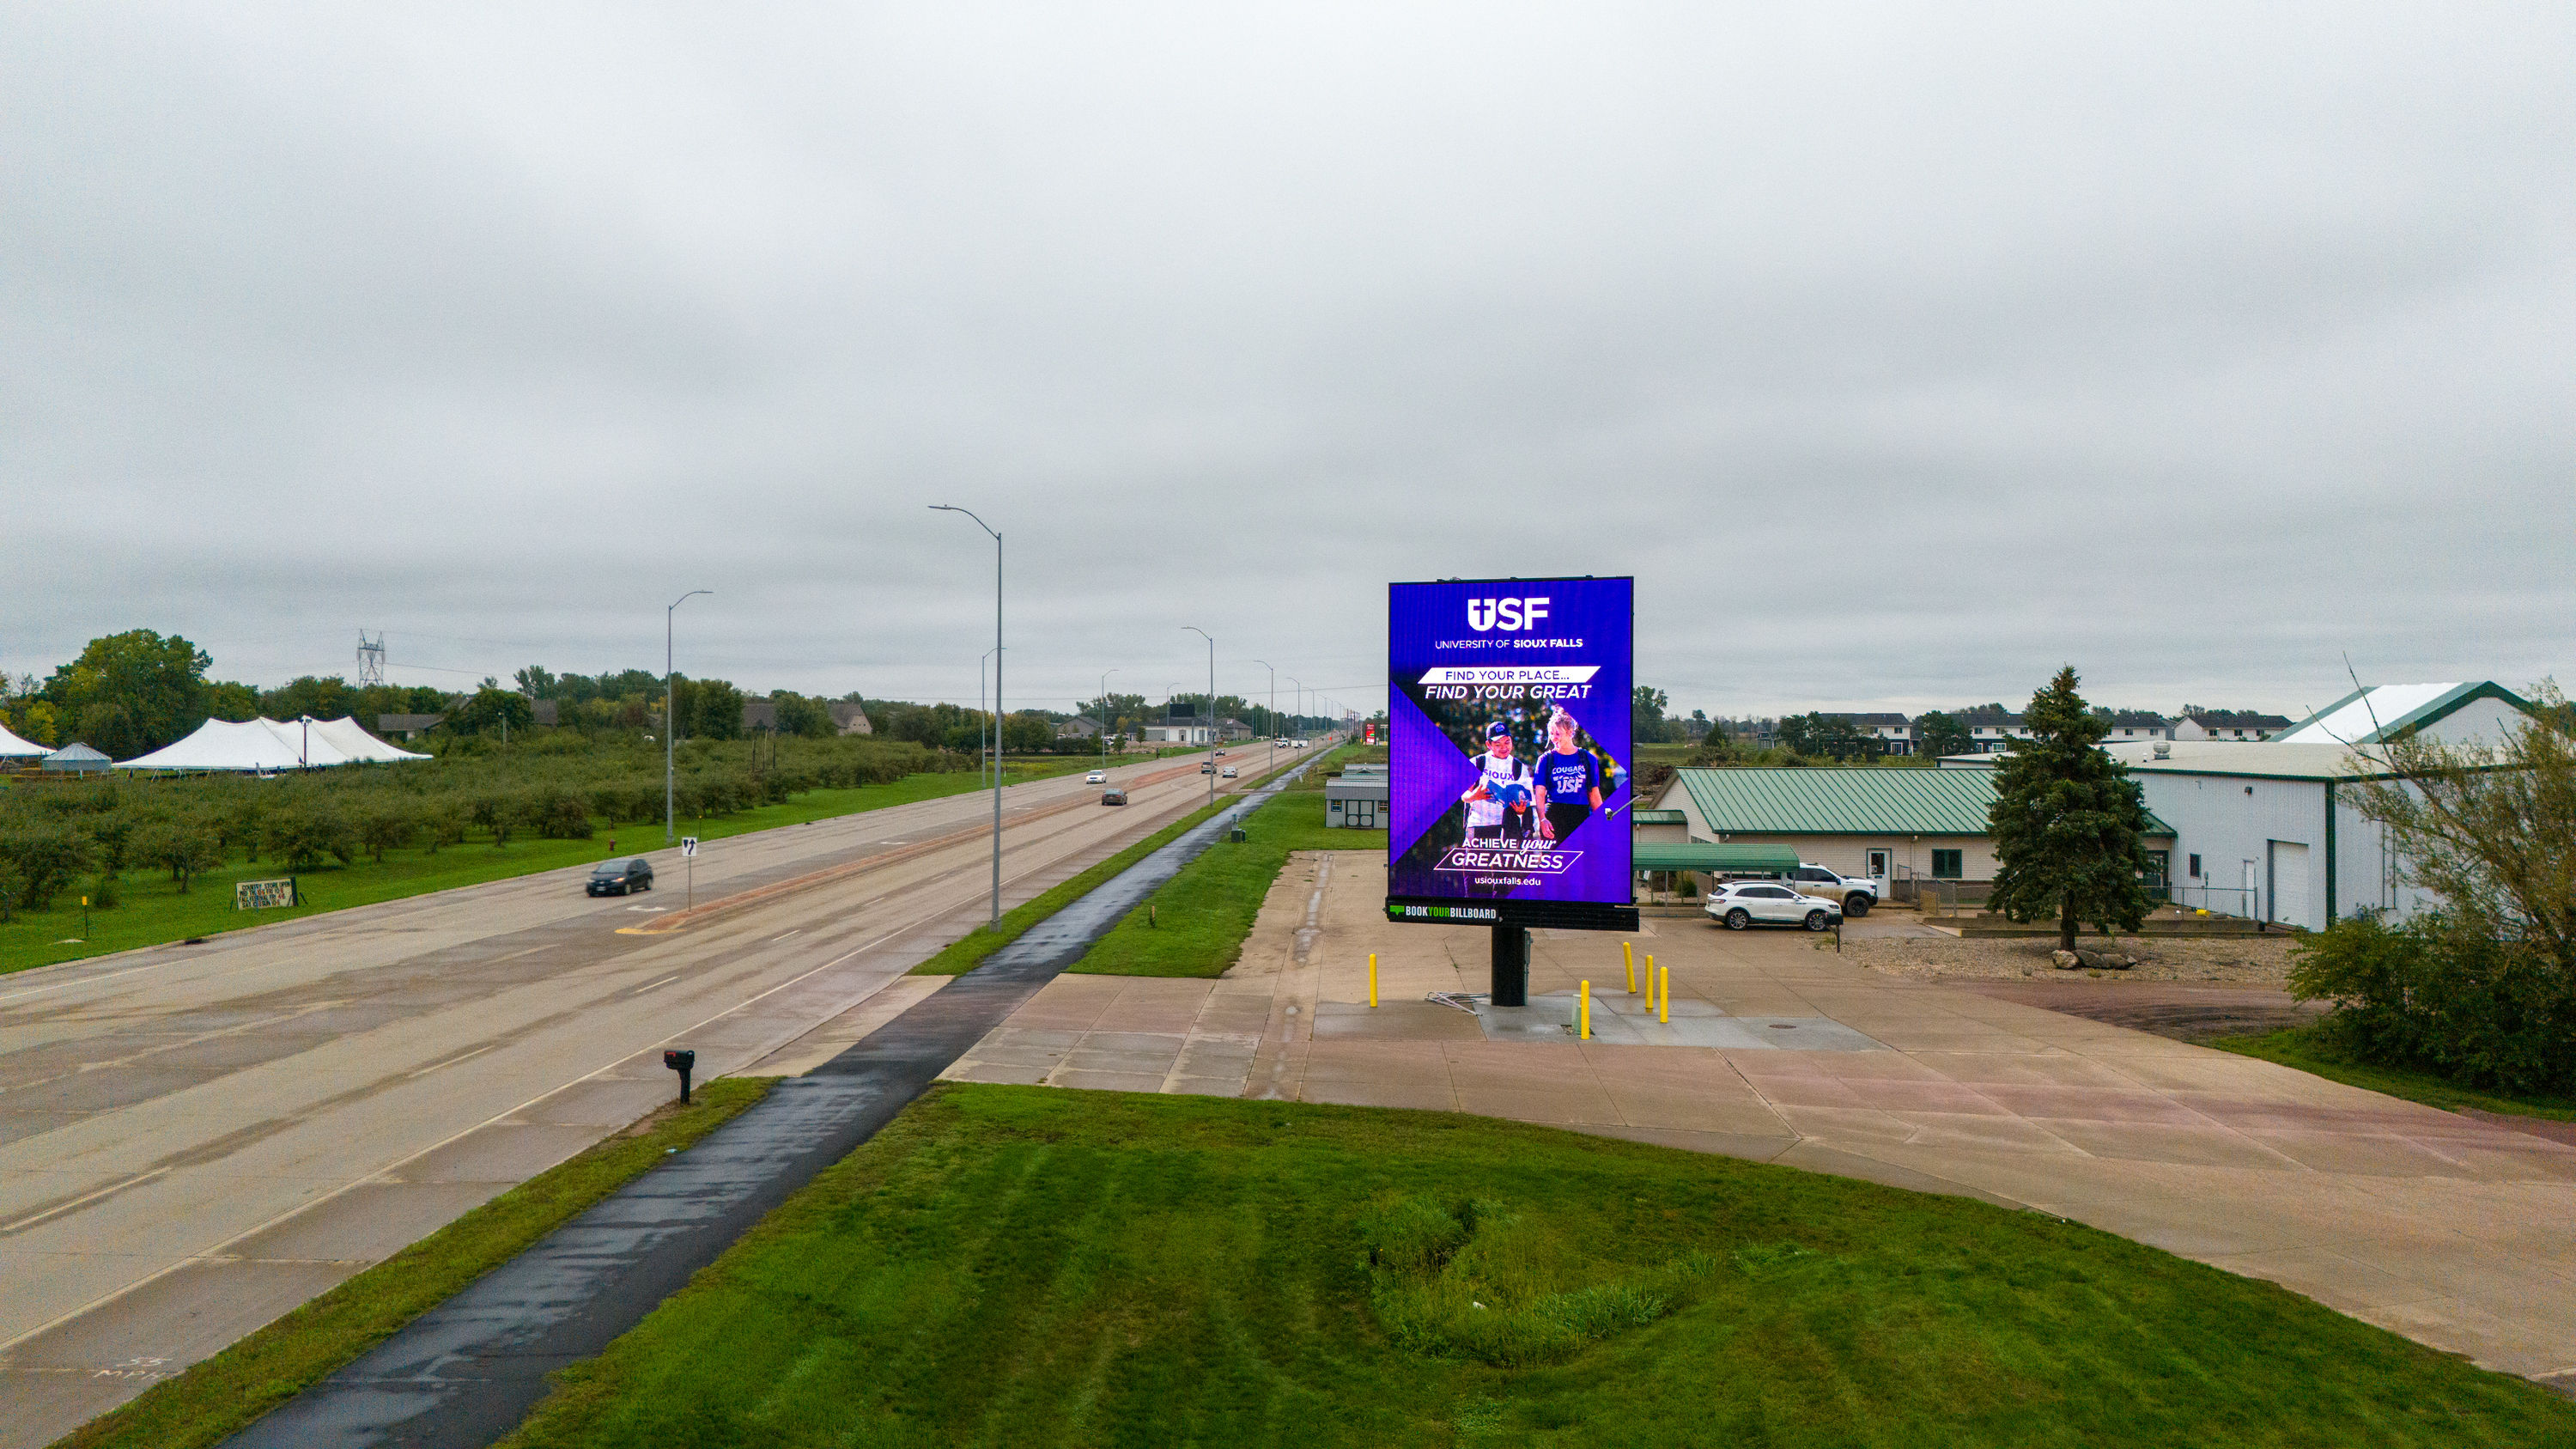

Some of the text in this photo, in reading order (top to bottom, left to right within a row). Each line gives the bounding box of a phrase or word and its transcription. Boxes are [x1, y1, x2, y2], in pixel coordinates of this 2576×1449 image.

[1467, 597, 1550, 631] USF
[1435, 638, 1583, 649] UNIVERSITY OF SIOUX FALLS
[1445, 670, 1571, 681] FIND YOUR PLACE...
[1425, 685, 1592, 699] FIND YOUR GREAT
[1483, 768, 1515, 782] SIOUX
[1552, 764, 1586, 775] COUGARS
[1556, 778, 1584, 794] USF
[1462, 838, 1557, 855] ACHIEVE your
[1451, 852, 1564, 869] GREATNESS
[1474, 876, 1541, 886] usiouxfalls.edu
